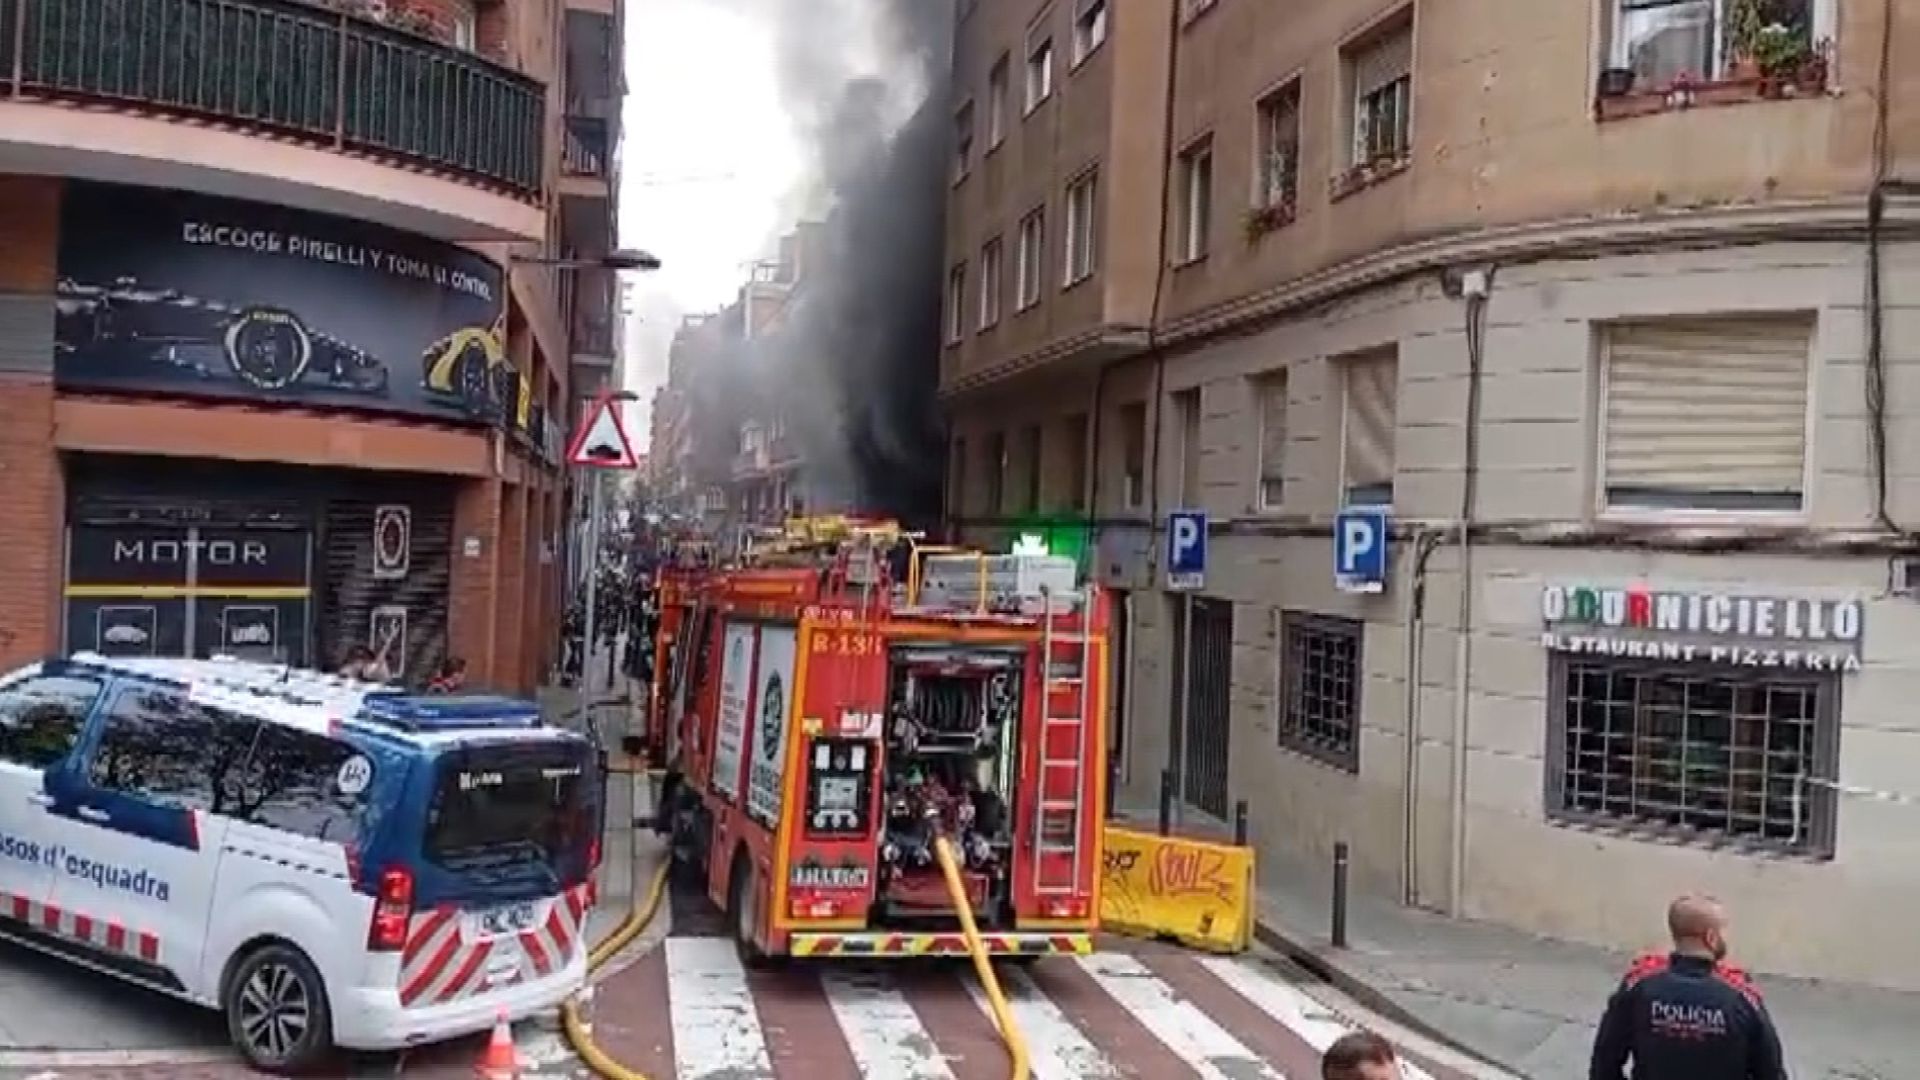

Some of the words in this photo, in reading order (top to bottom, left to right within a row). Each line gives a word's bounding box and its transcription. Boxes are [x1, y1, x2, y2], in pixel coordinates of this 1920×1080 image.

[183, 221, 281, 252] ESCOGE
[288, 235, 365, 267] PIRELLI
[370, 251, 382, 269] Y
[387, 254, 430, 279] TOMA
[113, 540, 267, 565] MOTOR
[1172, 517, 1199, 566] P
[1343, 520, 1374, 571] P
[1710, 646, 1862, 671] PIZZERIA
[43, 843, 170, 902] d'esquadra
